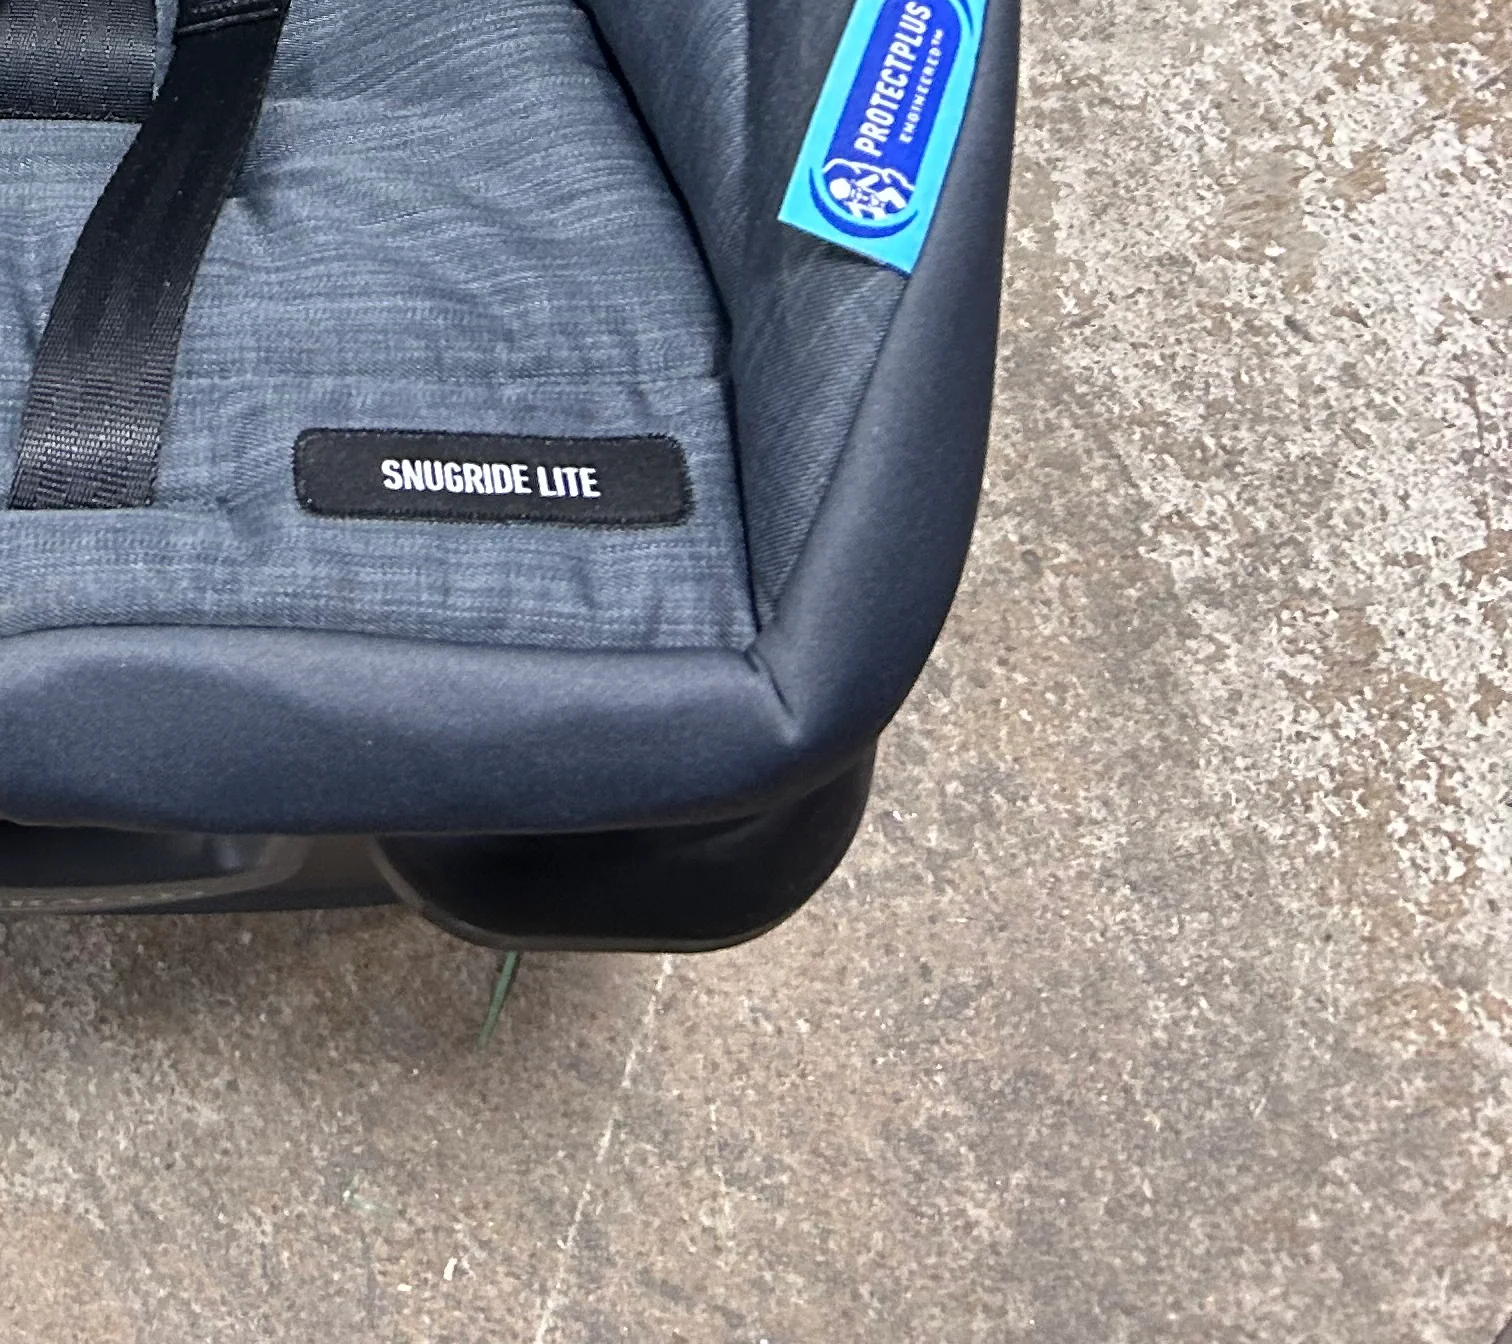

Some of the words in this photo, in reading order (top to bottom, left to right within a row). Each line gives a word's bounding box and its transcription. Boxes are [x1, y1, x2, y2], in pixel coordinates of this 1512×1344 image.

[854, 2, 932, 157] PROTECTPLUS
[381, 459, 532, 494] SNUGRIDE
[537, 466, 602, 498] LITE
